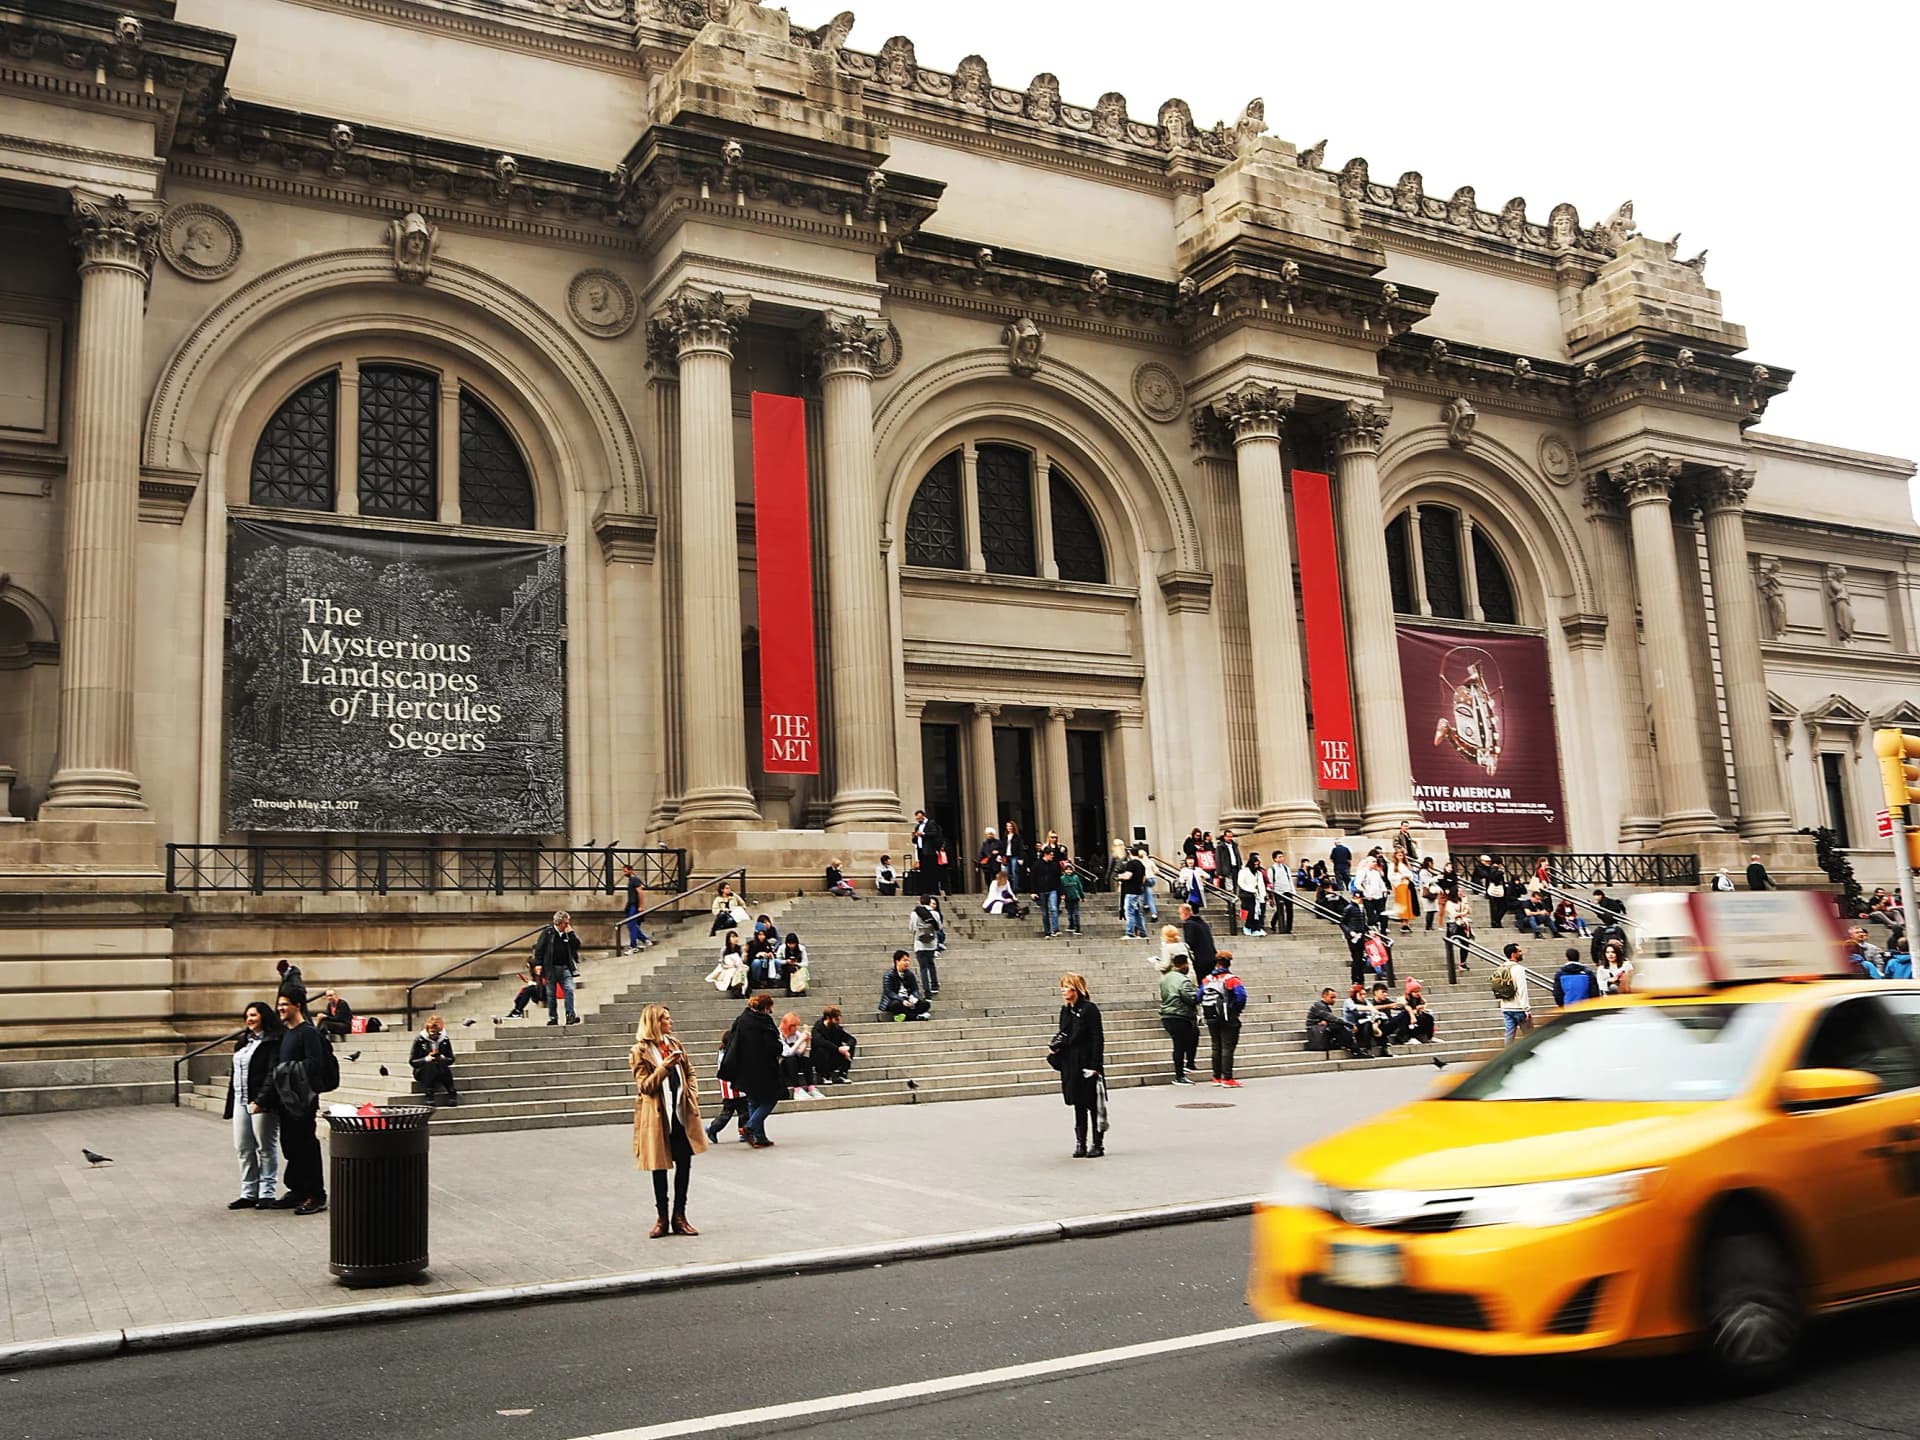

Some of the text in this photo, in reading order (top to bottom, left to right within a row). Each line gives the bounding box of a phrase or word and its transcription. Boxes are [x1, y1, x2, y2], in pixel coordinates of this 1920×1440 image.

[301, 598, 361, 626] The
[301, 628, 471, 663] Mysterious
[301, 659, 478, 697] Landscapes
[330, 689, 501, 724] of Hercules
[769, 715, 810, 738] THE
[388, 723, 485, 757] Segers
[769, 738, 811, 762] MET
[1320, 740, 1350, 760] THE
[1320, 760, 1351, 780] MET
[1452, 787, 1511, 799] AMERICAN
[252, 799, 359, 812] Through May 21, 2017
[1419, 800, 1495, 813] ASTERPIECES
